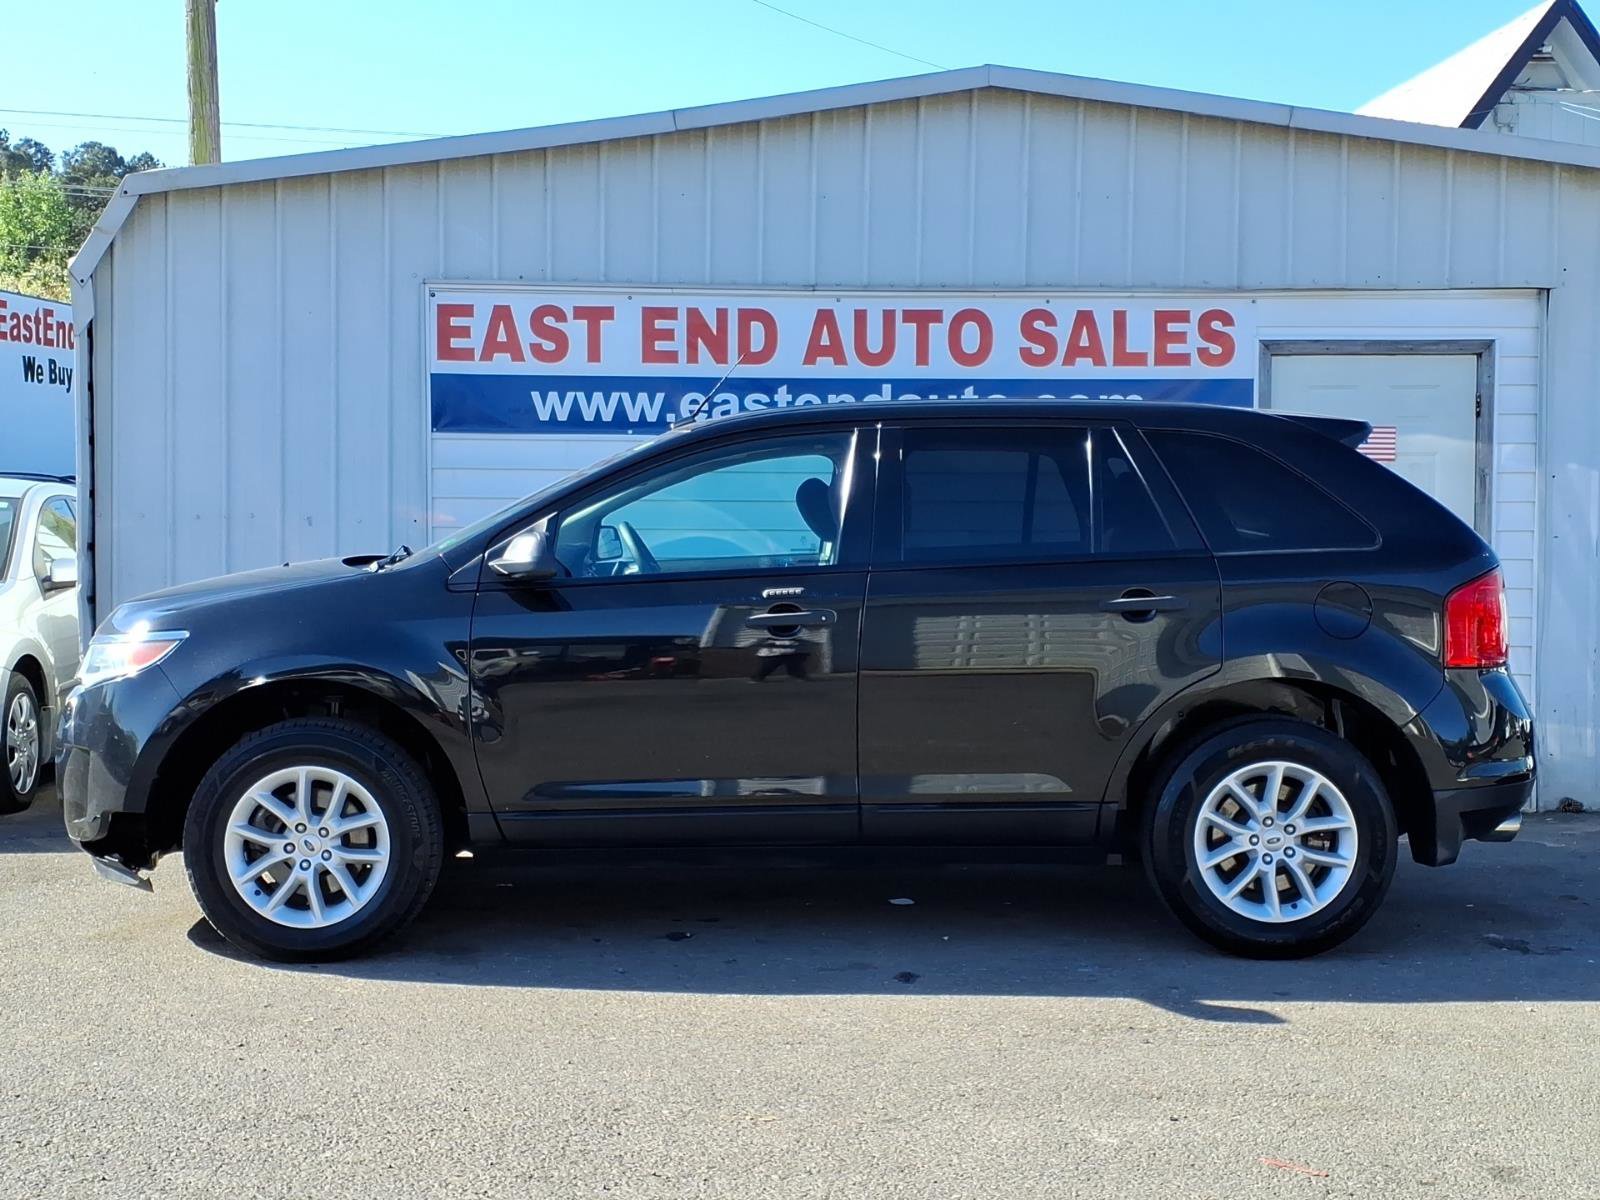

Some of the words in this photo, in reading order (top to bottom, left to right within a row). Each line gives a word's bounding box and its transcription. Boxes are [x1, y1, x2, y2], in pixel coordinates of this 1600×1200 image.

[436, 303, 615, 364] EAST
[641, 306, 779, 366] END
[802, 308, 994, 368] AUTO
[1018, 308, 1237, 368] SALES
[22, 355, 44, 384] We
[48, 358, 73, 393] Buy
